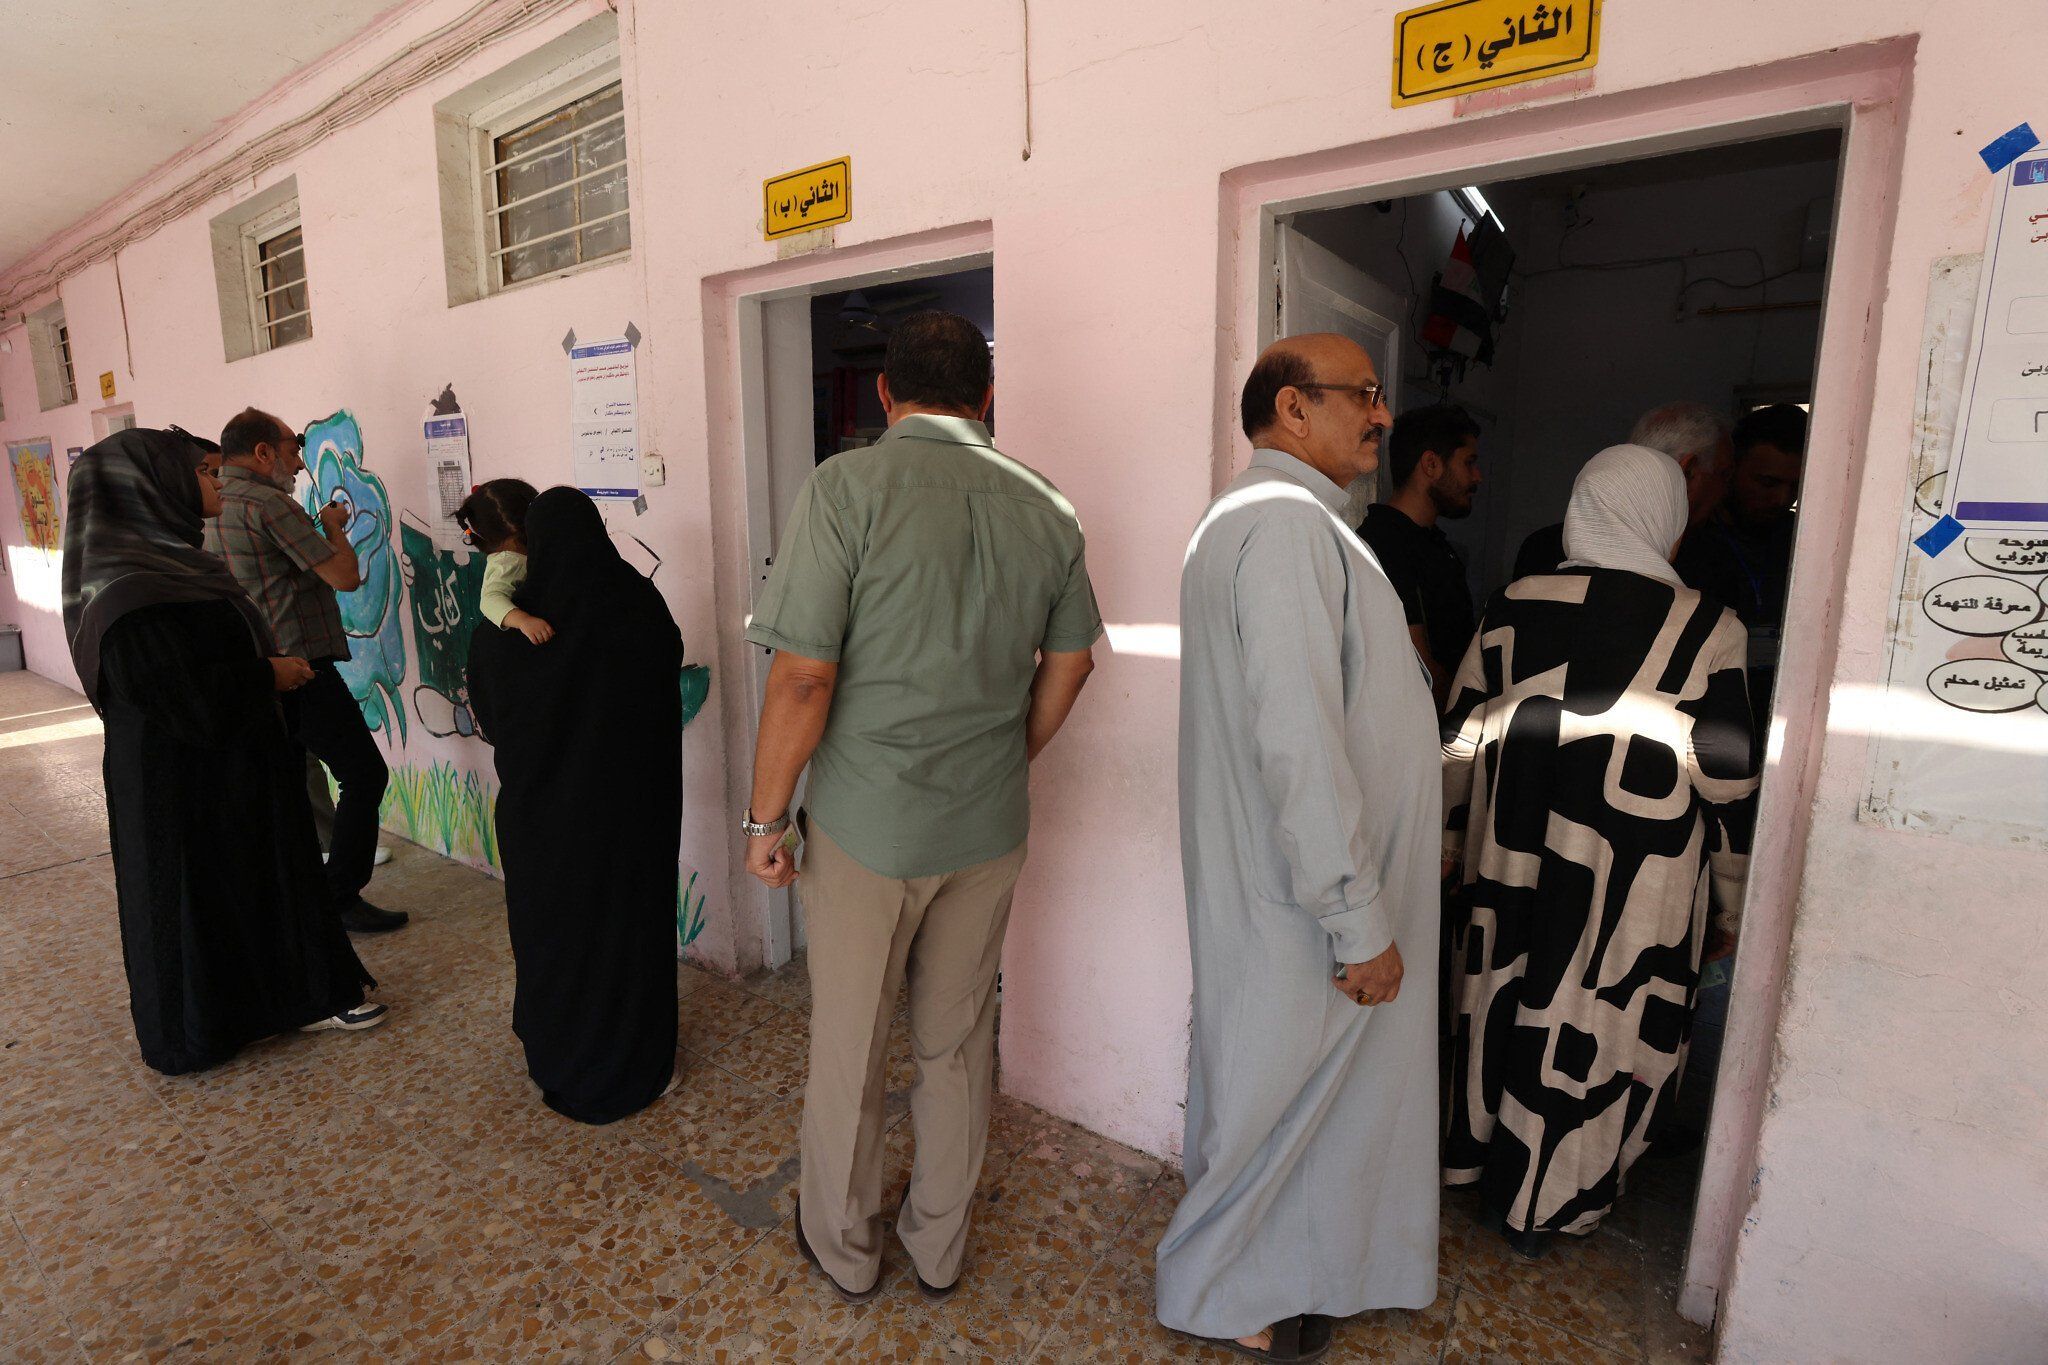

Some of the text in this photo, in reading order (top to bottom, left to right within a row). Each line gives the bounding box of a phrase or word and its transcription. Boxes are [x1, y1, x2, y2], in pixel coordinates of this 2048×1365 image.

[1477, 4, 1572, 70] الثاني
[800, 178, 839, 218] الثاني
[417, 567, 461, 651] كتابي
[1983, 596, 2031, 615] معرفة
[1983, 676, 2026, 692] تمثيل
